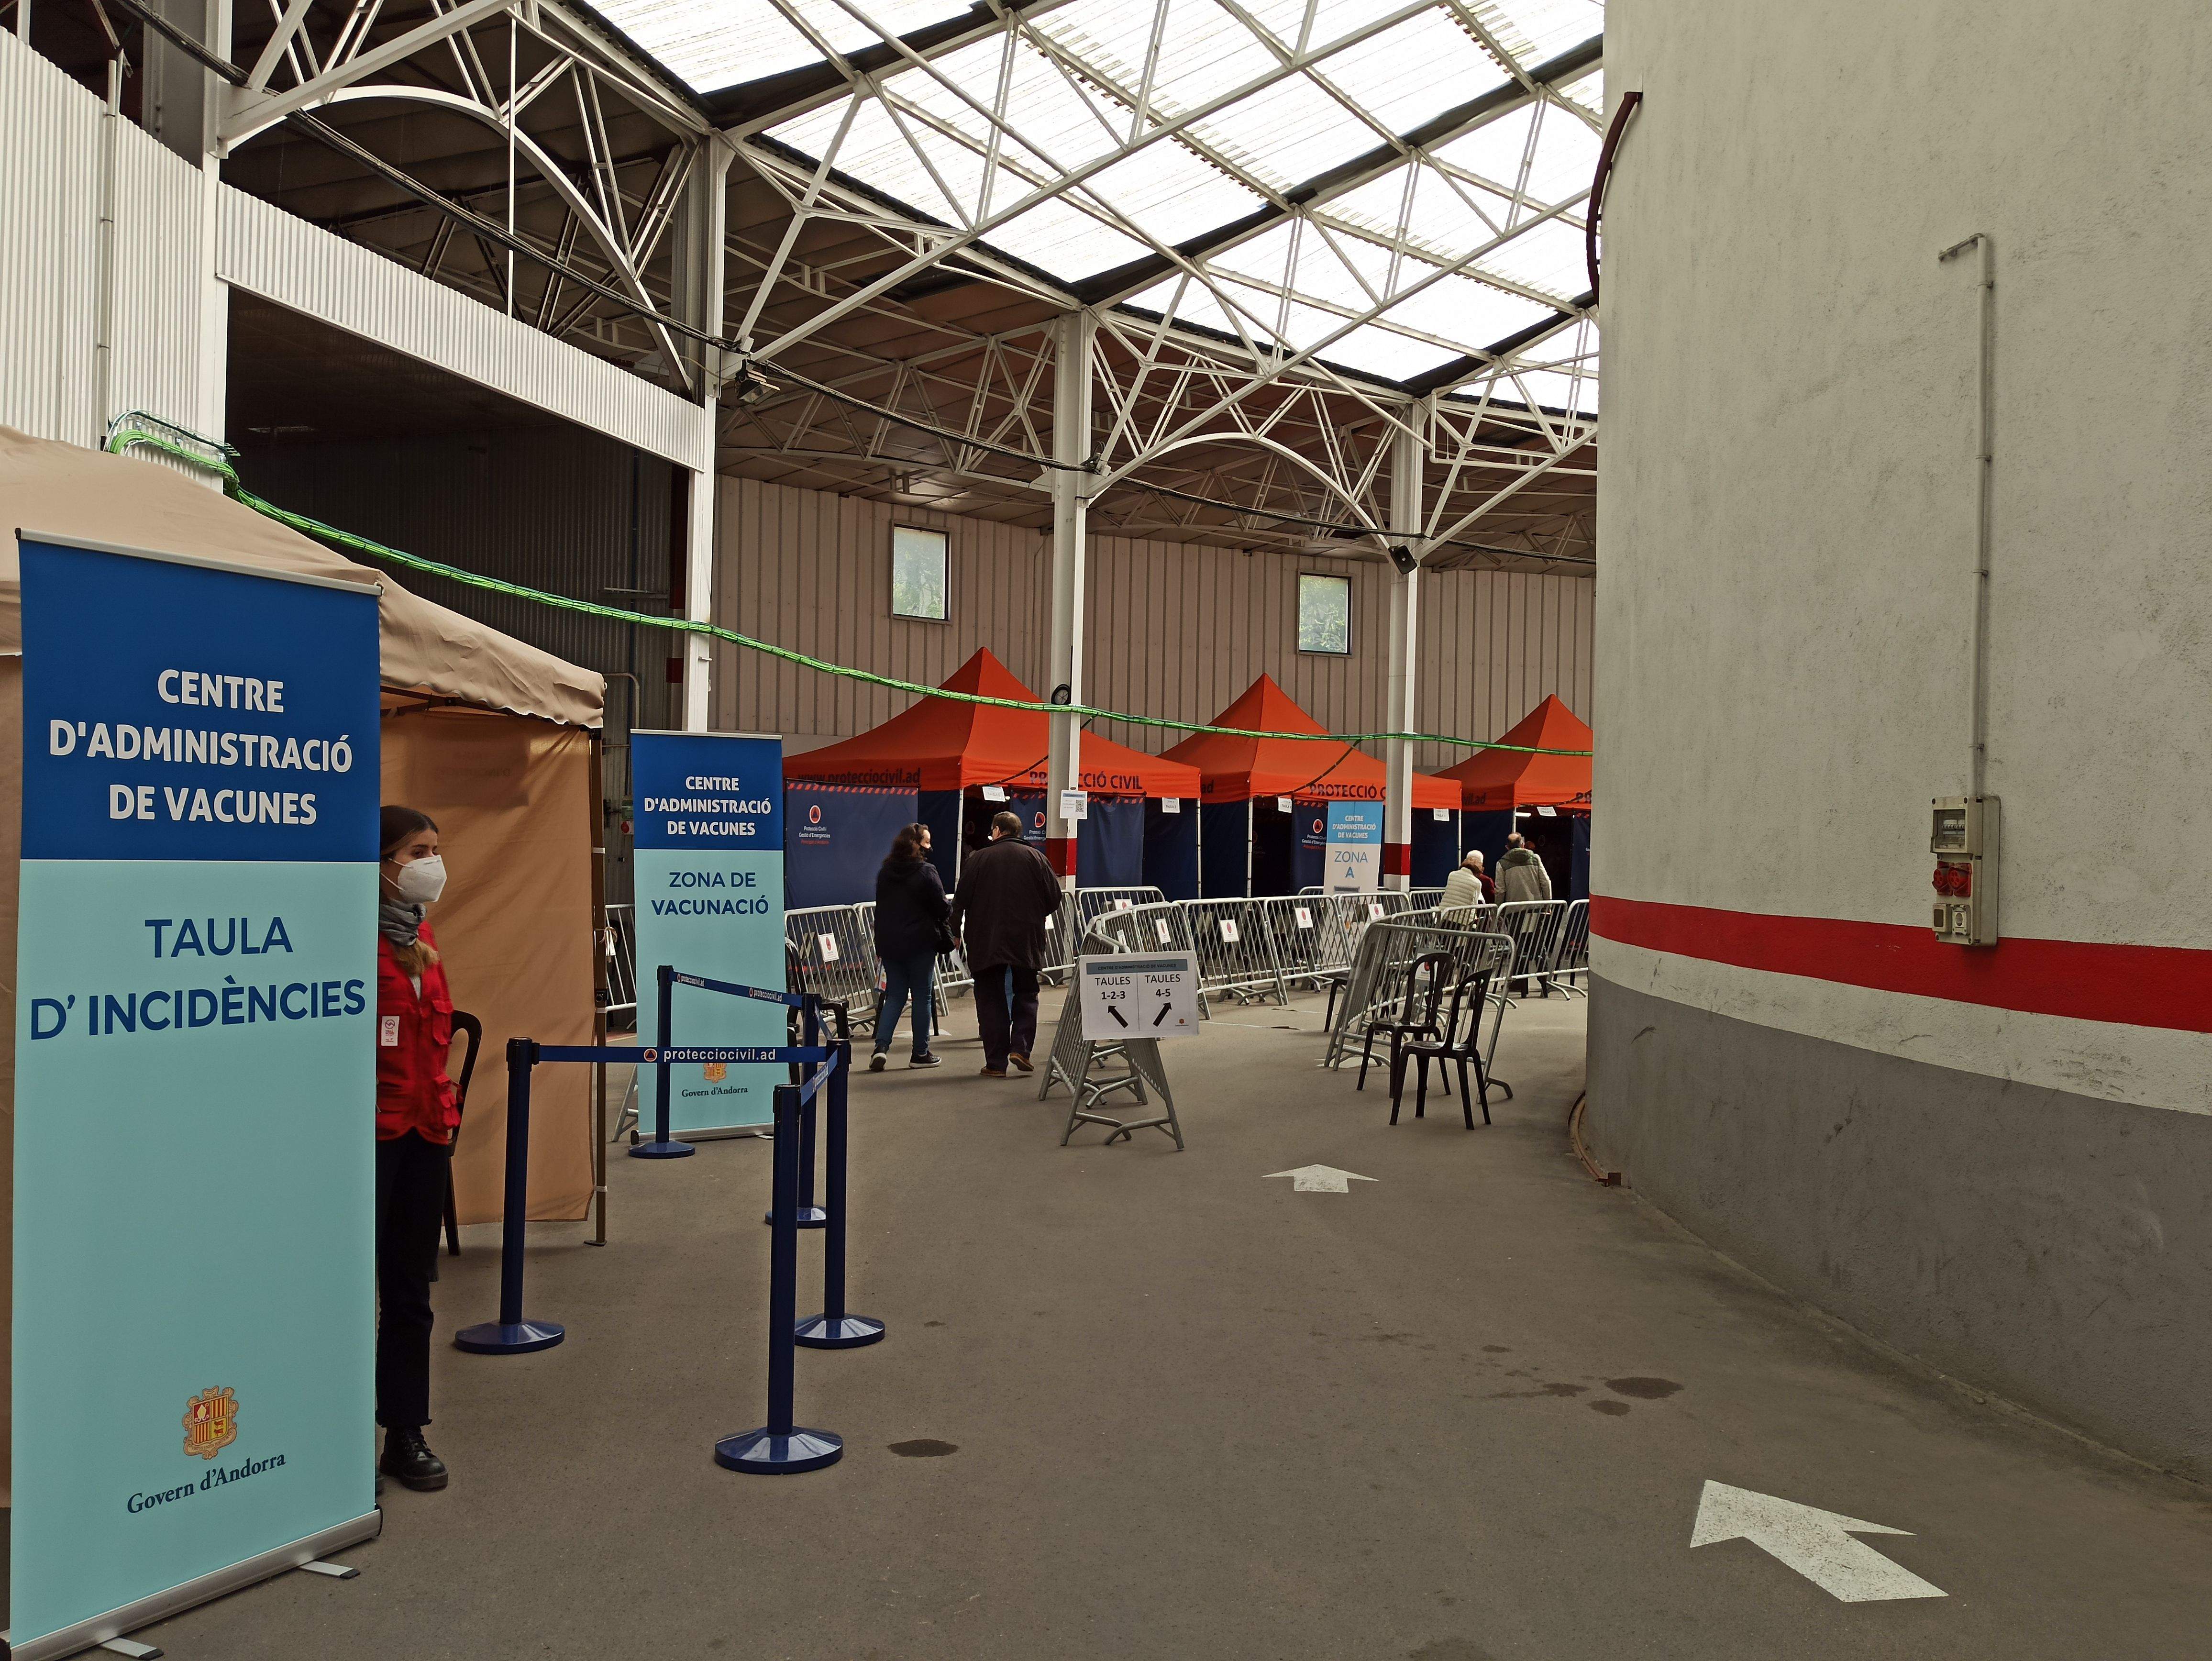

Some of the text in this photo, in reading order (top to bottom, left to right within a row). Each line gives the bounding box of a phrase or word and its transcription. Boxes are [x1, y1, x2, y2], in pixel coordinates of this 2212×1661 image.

[158, 669, 284, 713] CENTRE
[50, 720, 353, 773] D'ADMINISTRACIÓ
[686, 776, 740, 791] CENTRE
[1110, 775, 1143, 790] CIVIL
[1309, 783, 1378, 798] PROTECCIÓ
[110, 784, 317, 825] DE VACUNES
[644, 797, 771, 814] D'ADMINISTRACIÓ
[667, 820, 756, 836] DE VACUNES
[1334, 851, 1368, 863] ZONA
[1345, 866, 1354, 878] A
[669, 872, 756, 888] ZONA DE
[651, 895, 769, 916] VACUNACIÓ
[144, 917, 294, 959] TAULA
[681, 974, 705, 987] protecciocivil.ad
[1095, 976, 1130, 986] TAULES
[1144, 974, 1181, 984] TAULES
[753, 988, 783, 1002] protecciocivil.ad
[1101, 990, 1126, 1000] 1-2-3
[1155, 988, 1171, 997] 4-5
[663, 1048, 776, 1062] protecciocivil.ad
[681, 1088, 709, 1098] Govern
[127, 1453, 287, 1514] Govern d’Andorra
